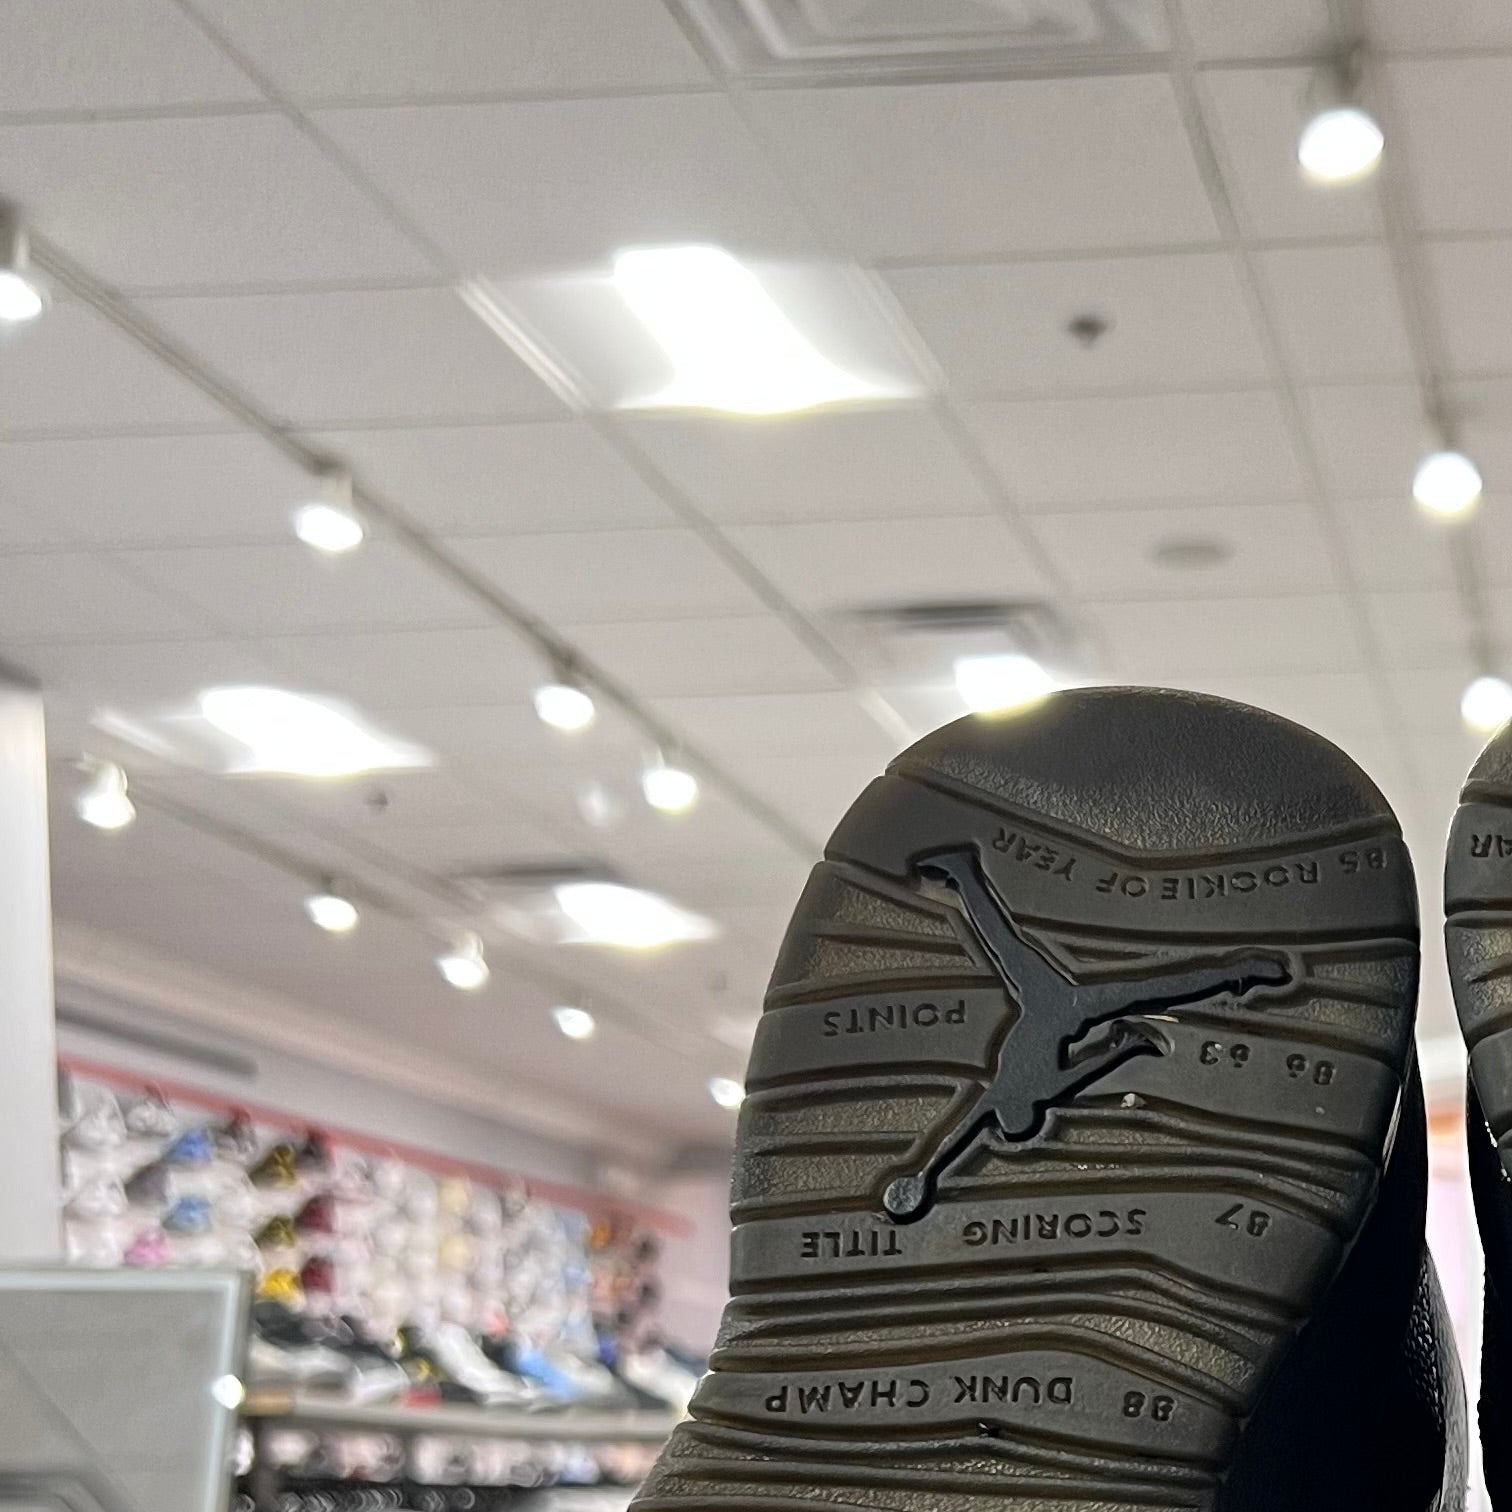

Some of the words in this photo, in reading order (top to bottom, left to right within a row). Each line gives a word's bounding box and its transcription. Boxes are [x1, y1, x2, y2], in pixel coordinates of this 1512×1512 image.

[991, 827, 1080, 881] YEAR
[1339, 849, 1388, 874] 85
[1095, 872, 1149, 900] OF
[1160, 862, 1320, 900] ROOKIE
[823, 1000, 966, 1038] POINTS
[1200, 1040, 1252, 1069] 63
[1285, 1051, 1336, 1087] 86
[962, 1208, 1147, 1247] SCORING
[1215, 1203, 1271, 1238] 87
[800, 1230, 903, 1259] TITLE
[764, 1379, 931, 1414] CHAMP
[953, 1375, 1074, 1405] DUNK
[1122, 1390, 1179, 1422] 88
